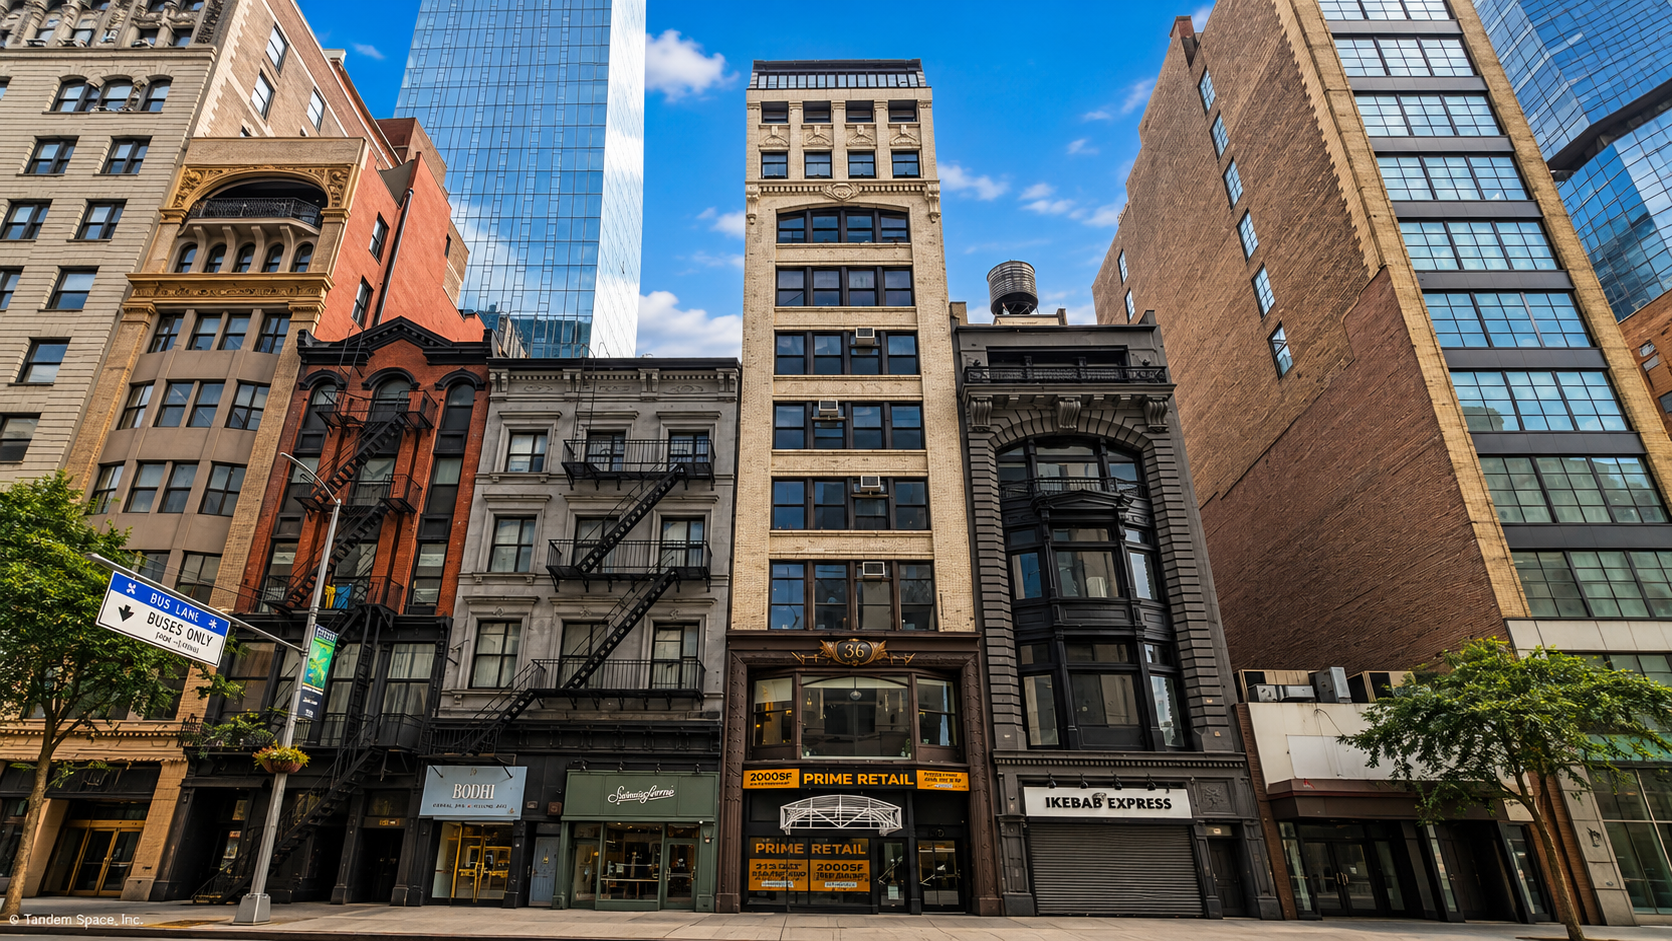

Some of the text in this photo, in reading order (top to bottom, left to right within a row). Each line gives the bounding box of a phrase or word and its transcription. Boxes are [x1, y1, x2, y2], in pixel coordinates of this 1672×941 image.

[150, 592, 200, 623] BUS LANE
[147, 611, 183, 636] BUSES
[186, 628, 214, 647] ONLY
[844, 644, 865, 658] 36
[750, 772, 792, 782] 2000SF
[803, 773, 853, 785] PRIME
[857, 773, 915, 786] RETAIL
[451, 783, 496, 800] BODHI
[1045, 797, 1173, 810] IKEBAB EXPRESS
[755, 843, 867, 855] PRIME RETAIL
[816, 863, 864, 871] 2000SF
